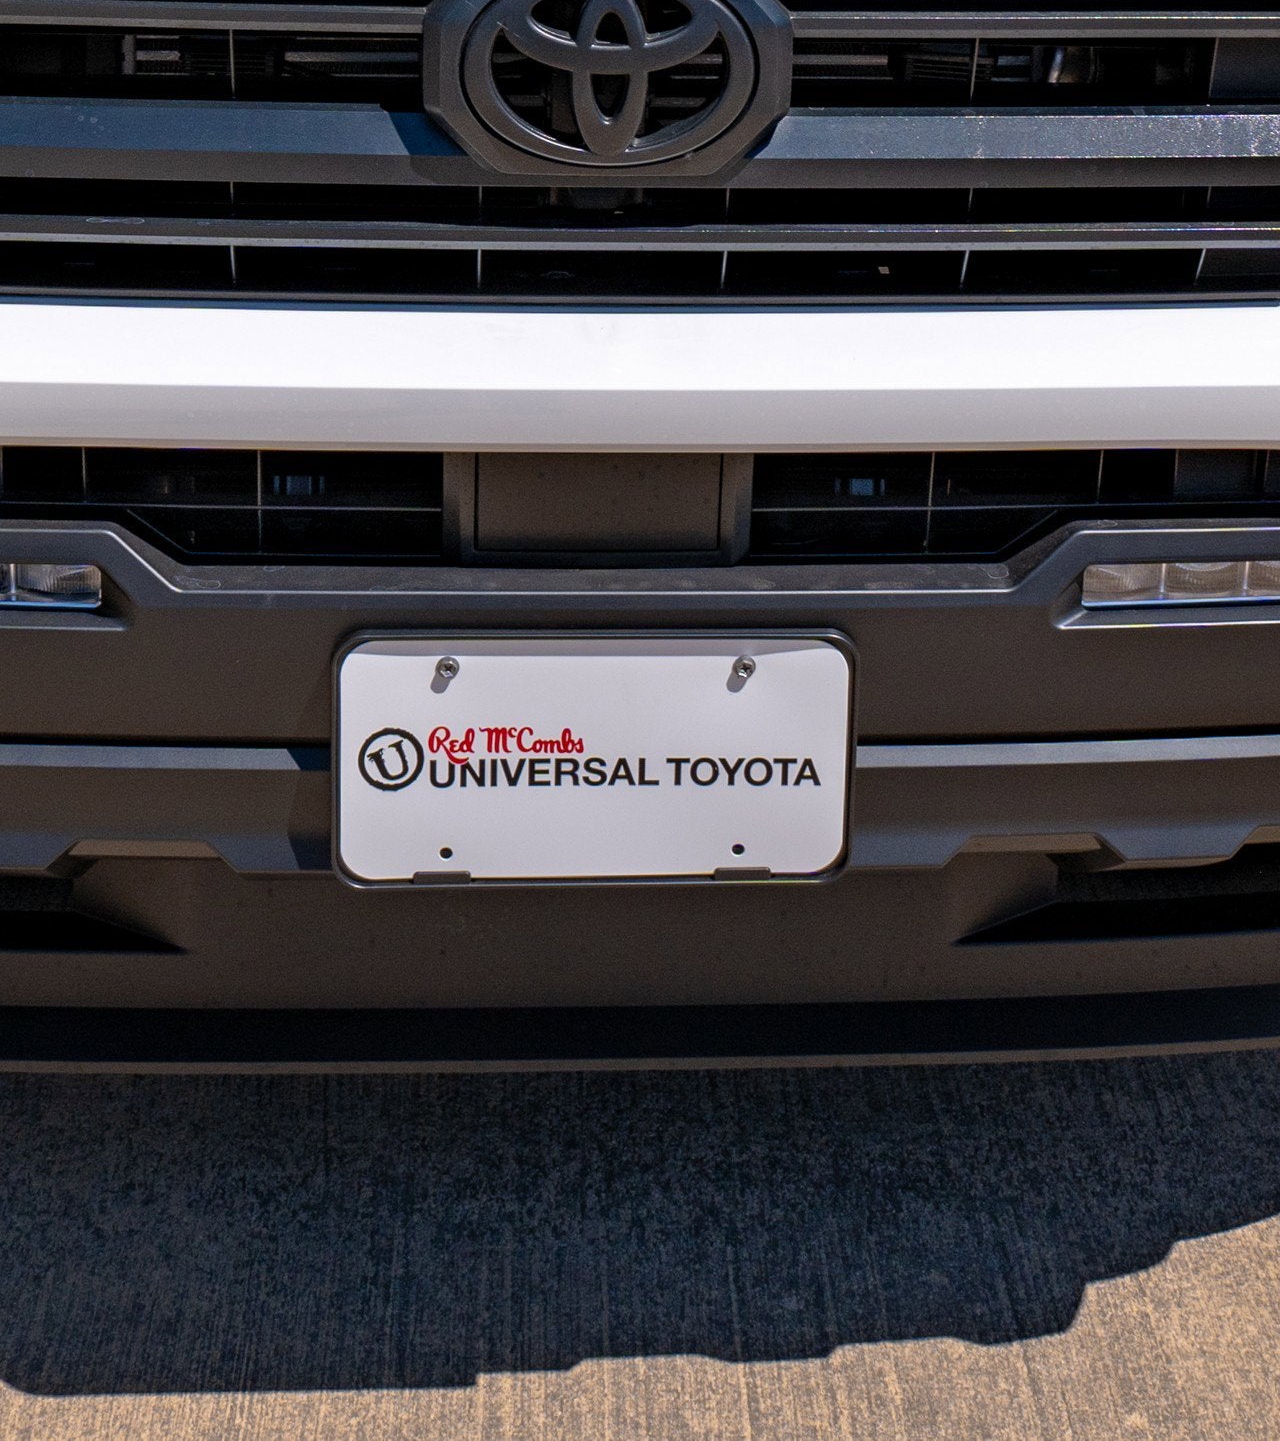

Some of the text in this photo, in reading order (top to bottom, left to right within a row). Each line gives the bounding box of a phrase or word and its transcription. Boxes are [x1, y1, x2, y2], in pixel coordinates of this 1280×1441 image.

[428, 726, 584, 765] Red McCombs
[429, 757, 821, 789] UNIVERSAL TOYOTA
